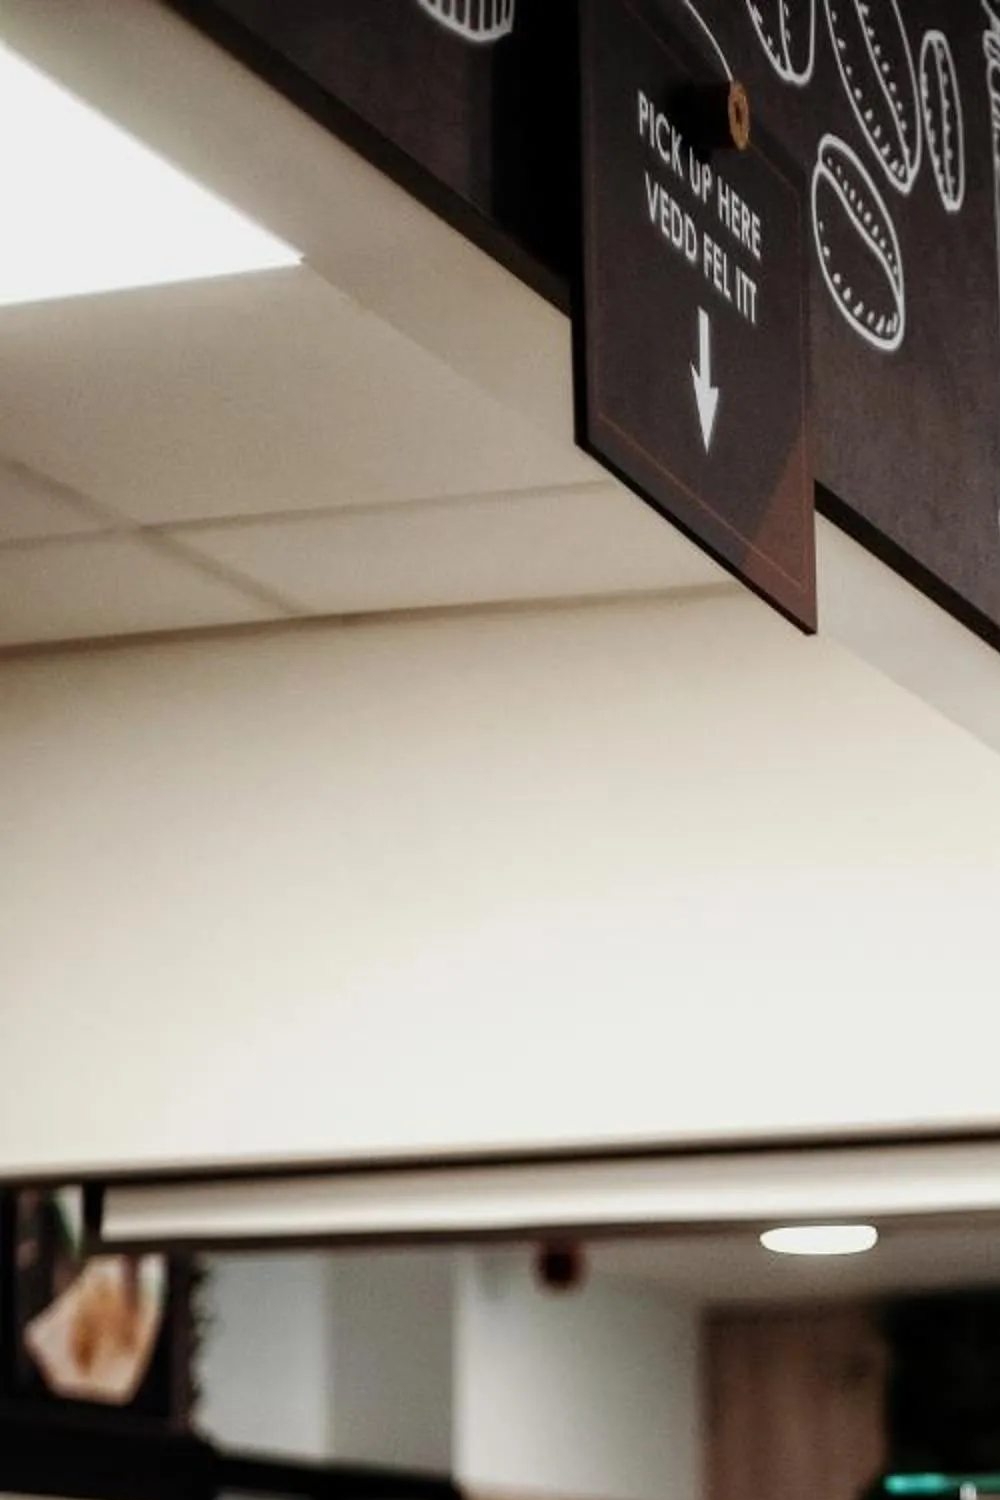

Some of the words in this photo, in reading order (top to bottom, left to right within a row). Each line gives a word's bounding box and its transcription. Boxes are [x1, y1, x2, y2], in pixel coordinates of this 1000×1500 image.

[638, 89, 683, 177] PICK
[690, 147, 711, 203] UP
[718, 176, 761, 260] HERE
[645, 171, 697, 262] VEDD
[703, 232, 731, 301] FEL
[736, 267, 757, 324] ITT
